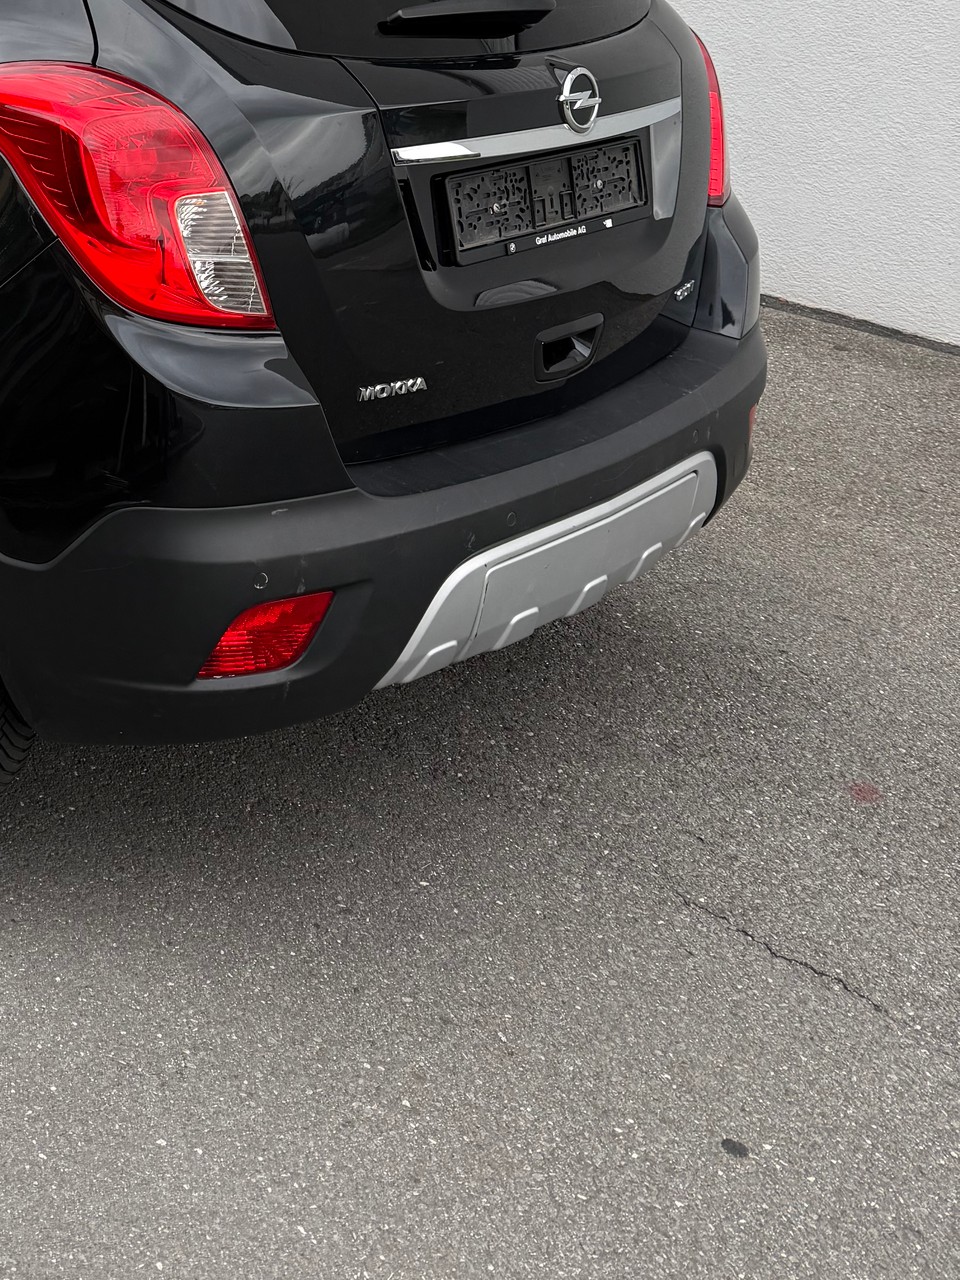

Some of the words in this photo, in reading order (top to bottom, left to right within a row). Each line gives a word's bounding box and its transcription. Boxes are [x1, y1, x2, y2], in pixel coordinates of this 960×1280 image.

[548, 228, 577, 242] Automobile
[578, 225, 587, 235] AG
[357, 376, 428, 402] MOKKA
